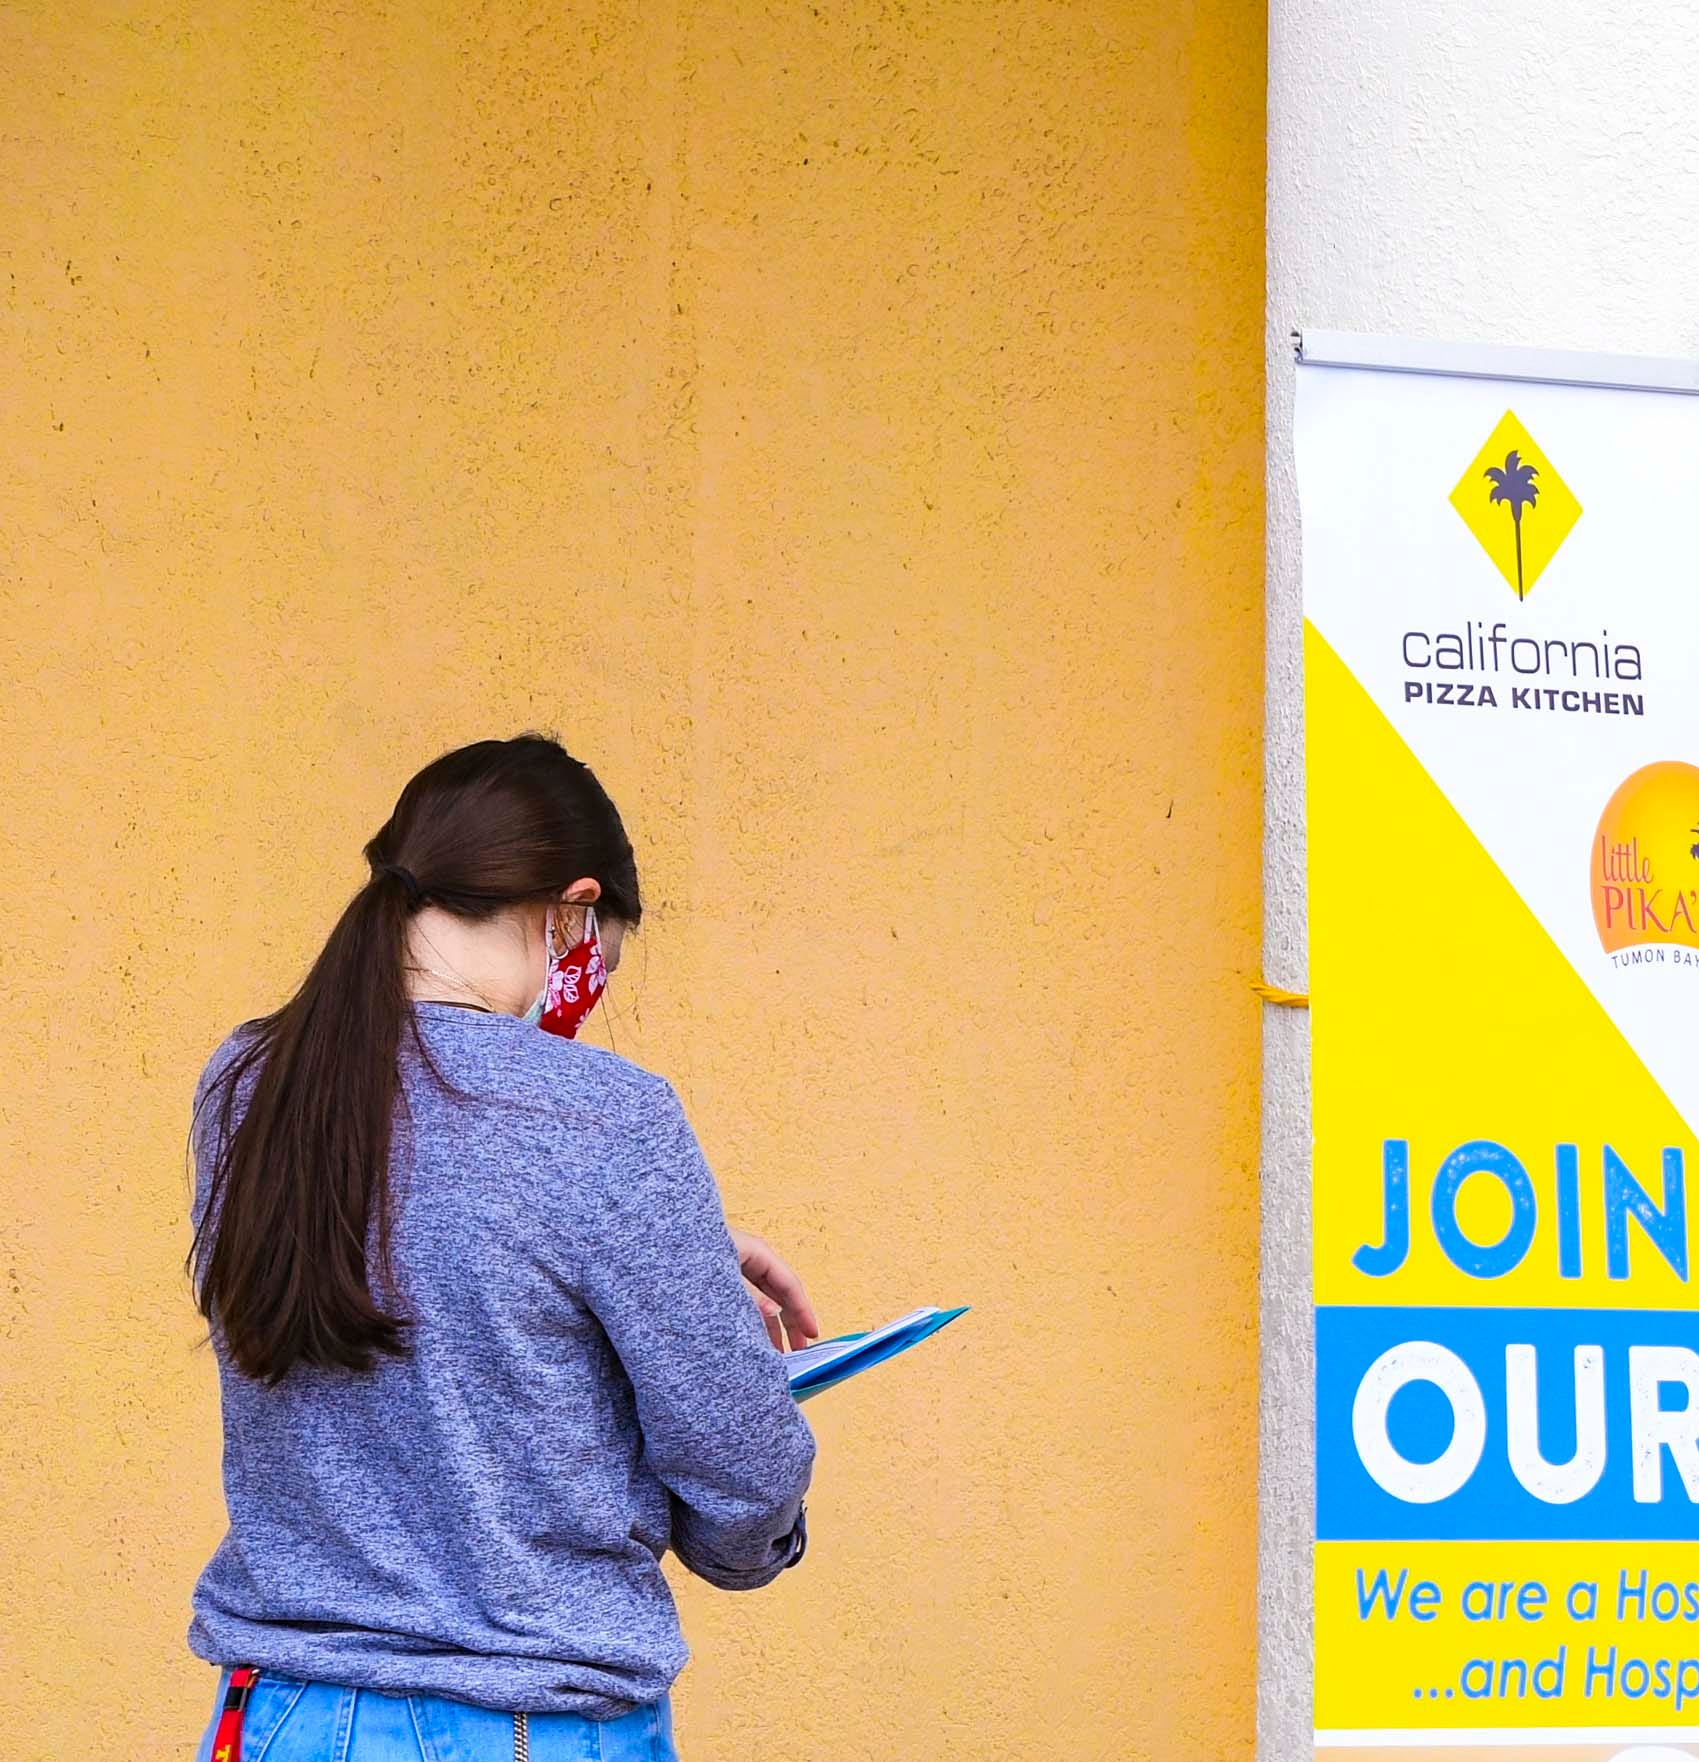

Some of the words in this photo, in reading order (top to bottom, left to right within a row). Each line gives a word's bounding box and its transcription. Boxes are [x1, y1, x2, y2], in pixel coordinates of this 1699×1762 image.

[1402, 620, 1642, 681] california
[1404, 681, 1498, 708] PIZZA
[1511, 687, 1645, 716] KITCHEN
[1601, 835, 1654, 884] little
[1611, 948, 1665, 969] TUMON
[1351, 1138, 1692, 1284] JOIN
[1356, 1567, 1443, 1622] We
[1460, 1580, 1549, 1622] are
[1565, 1580, 1599, 1622] a
